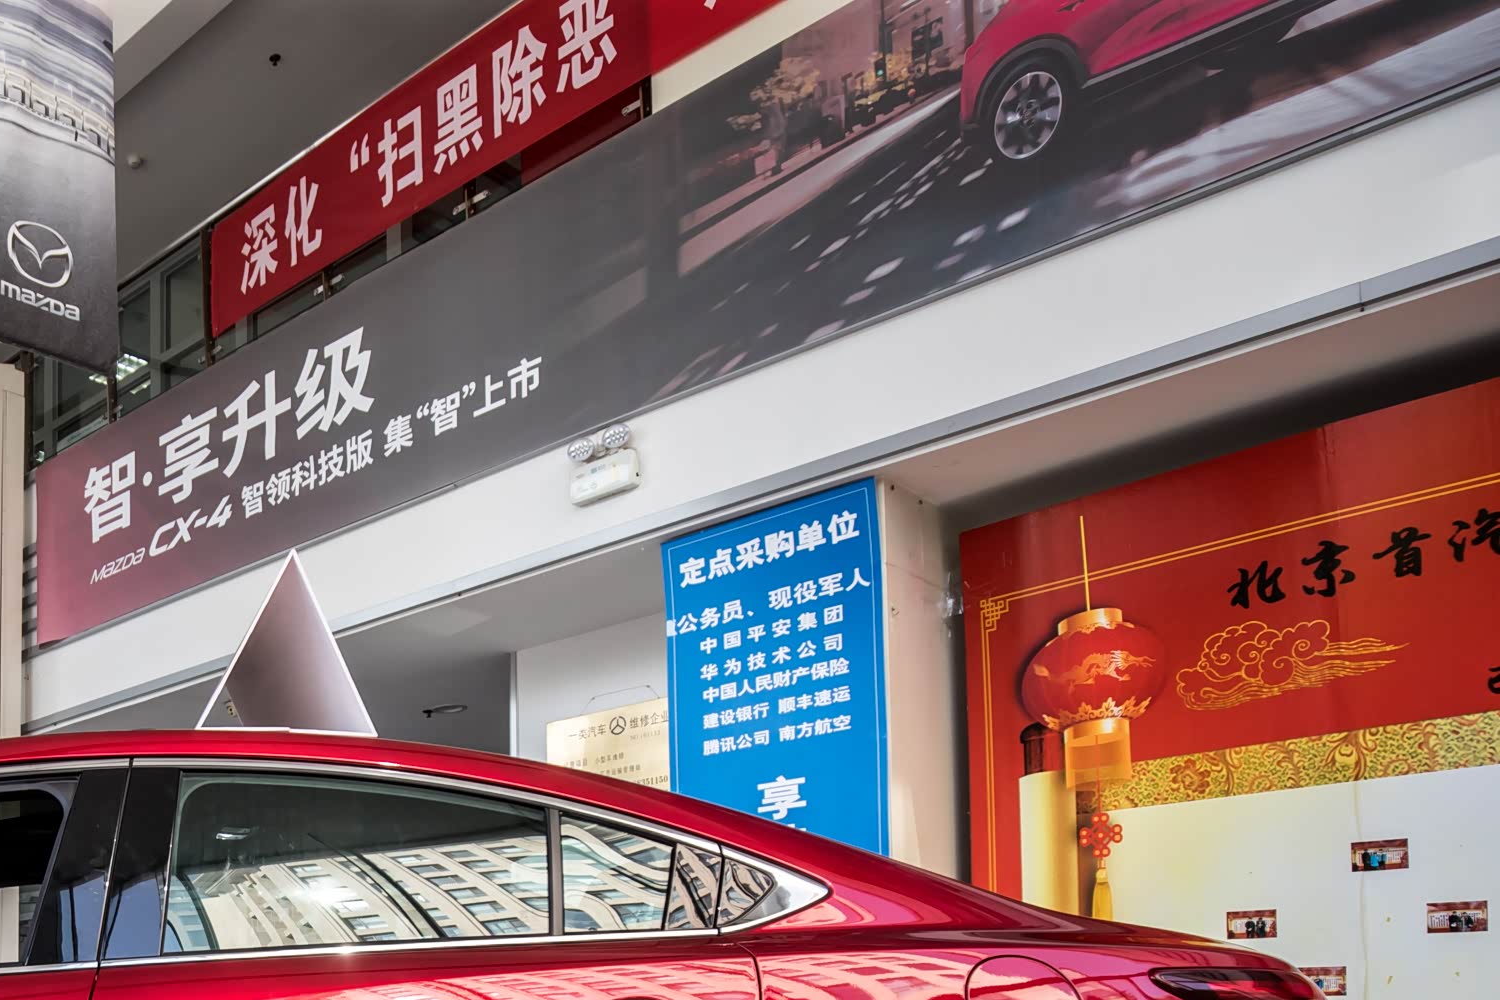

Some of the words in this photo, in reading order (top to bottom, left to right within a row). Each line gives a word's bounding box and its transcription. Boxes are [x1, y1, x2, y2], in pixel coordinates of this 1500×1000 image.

[349, 0, 717, 207] “扫黑除恶
[0, 279, 80, 321] mazda
[83, 326, 375, 543] 智·享升级
[149, 494, 233, 557] CX-4
[241, 430, 374, 520] 智领科技版
[383, 356, 542, 458] 集“智”上市
[679, 510, 860, 589] 定点采购单位
[703, 658, 850, 703] 中国人民财产保险
[703, 701, 770, 730] 建设银行
[778, 686, 851, 715] 顺丰速运
[703, 729, 770, 757] 腾讯公司
[779, 714, 852, 742] 南方航空
[757, 774, 807, 820] 享
